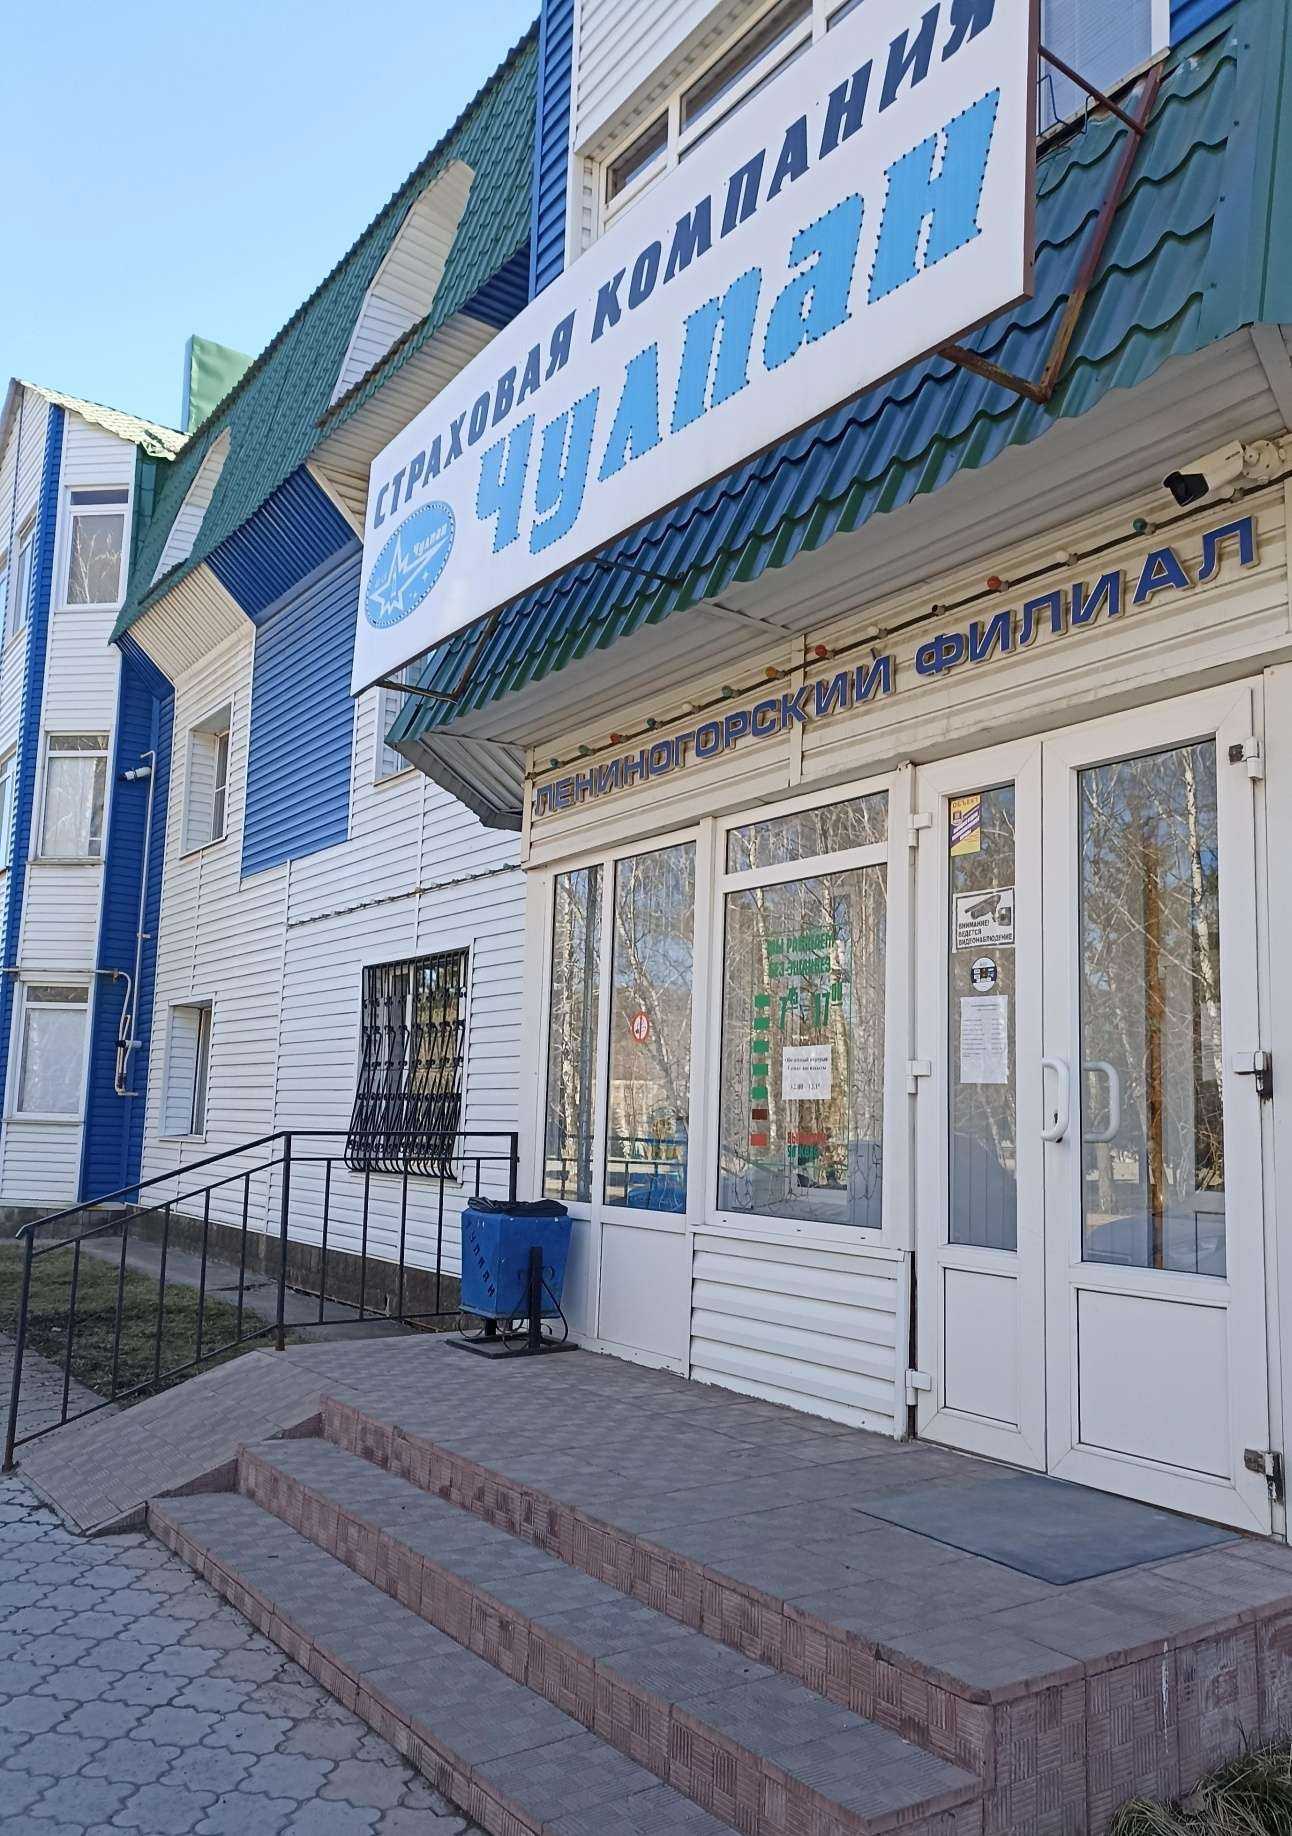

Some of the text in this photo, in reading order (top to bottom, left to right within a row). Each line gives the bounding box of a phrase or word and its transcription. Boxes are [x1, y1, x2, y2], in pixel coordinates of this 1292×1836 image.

[374, 0, 995, 529] СТРАХОВАЯ КОМПАНИЯ
[533, 515, 1258, 818] ЛЕНИНОГОРСКИЙ ФИЛИАЛ
[958, 919, 989, 930] ВНИМАНИЕ!
[958, 929, 982, 938] ВЕДЕТСЯ
[958, 933, 1013, 946] ВИДЕОНАБЛЮДЕНИЕ
